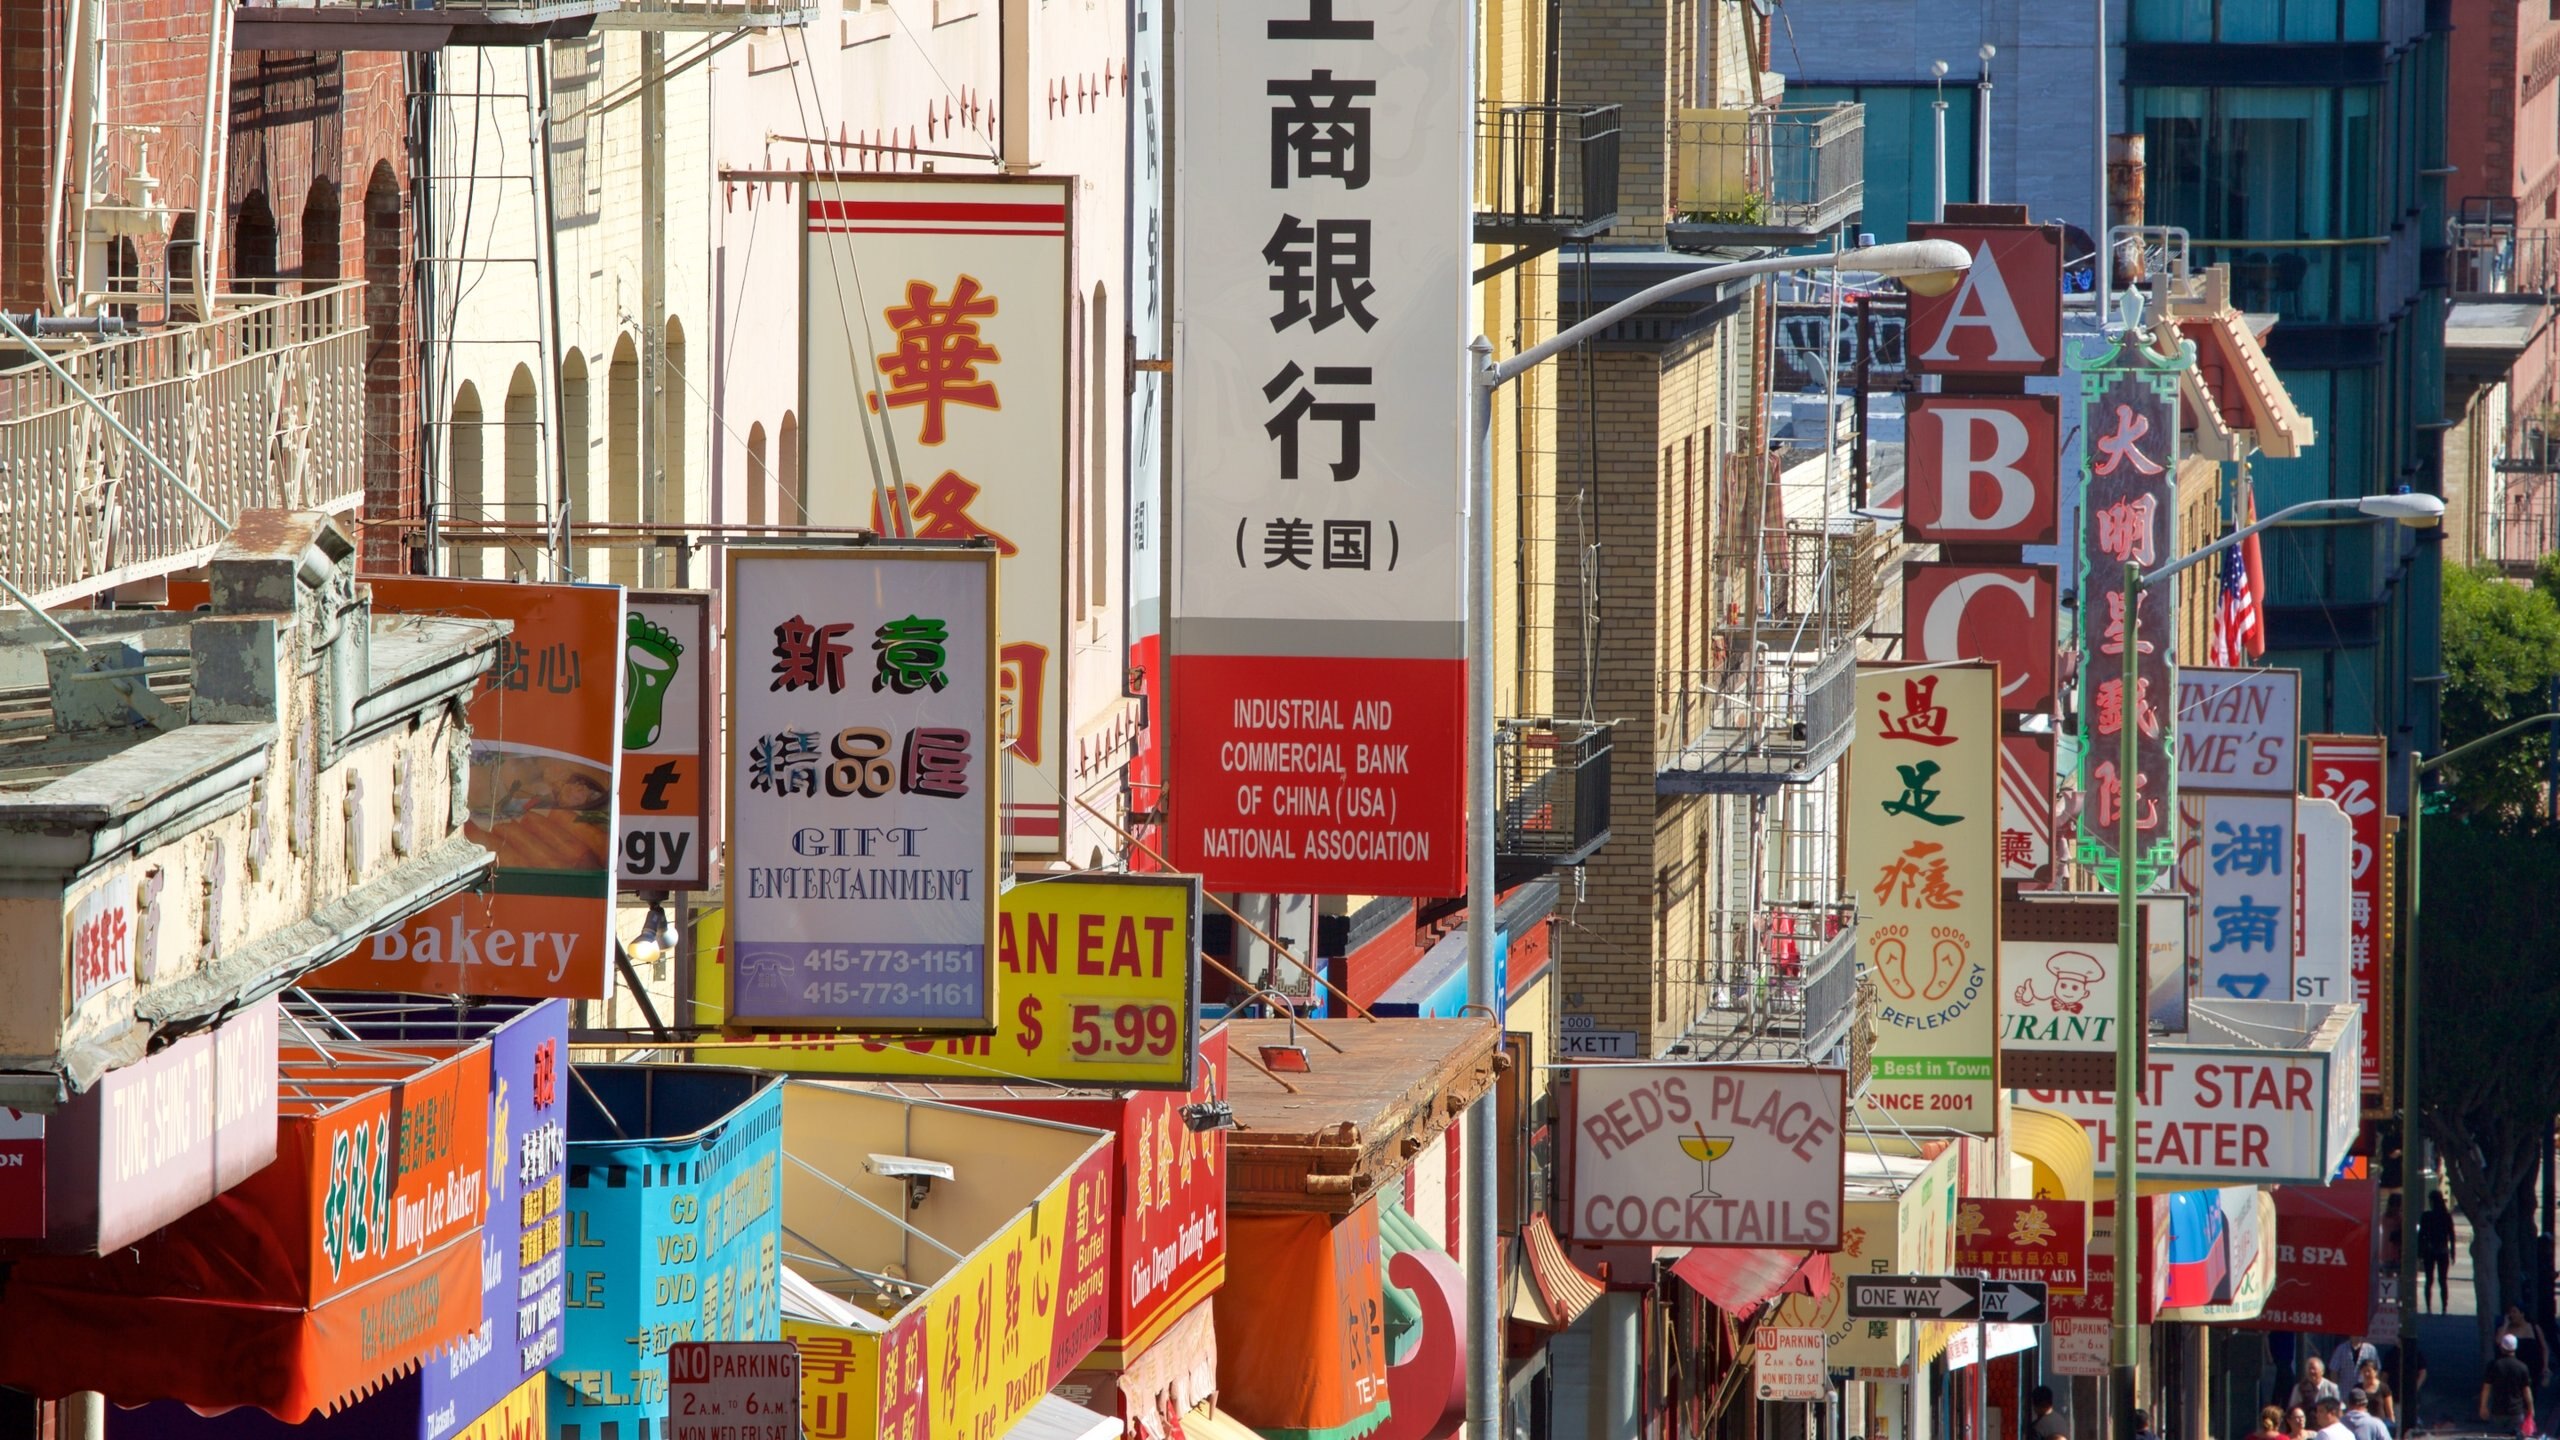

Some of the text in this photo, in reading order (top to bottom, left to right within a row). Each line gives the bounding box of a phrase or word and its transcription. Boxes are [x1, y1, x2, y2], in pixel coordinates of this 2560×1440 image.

[1235, 516, 1400, 572] (美国)
[770, 614, 949, 694] 新意
[1234, 699, 1392, 730] INDUSTRIAL AND
[749, 726, 973, 799] 精品屋
[1221, 741, 1409, 774] COMMERCIAL BANK
[1238, 785, 1262, 815] OF
[1273, 786, 1330, 816] CHINA
[620, 829, 691, 875] gy
[792, 827, 928, 858] GIFT
[1204, 828, 1429, 861] NATIONAL ASSOCIATION
[748, 867, 973, 902] ENTERTAINMENT
[372, 915, 580, 982] Bakery
[804, 949, 973, 973] 415-773-1151
[1078, 914, 1174, 978] EAT
[804, 982, 973, 1006] 415-773-1161
[1882, 963, 1986, 1030] REFLEXOLOGY
[2296, 977, 2330, 997] ST
[1017, 993, 1043, 1057] $
[1072, 1003, 1177, 1057] 5.99
[1884, 1061, 1922, 1075] Best
[1927, 1061, 1942, 1075] in
[1947, 1061, 1991, 1076] Town
[1867, 1094, 1973, 1110] SINCE 2001
[2193, 1064, 2314, 1112] STAR
[1582, 1075, 1834, 1164] RED'S PLACE
[396, 1195, 425, 1255] Wong
[426, 1183, 444, 1236] Lee
[446, 1164, 481, 1227] Bakery
[671, 1195, 698, 1223] CD
[1076, 1169, 1107, 1243] 點心
[1585, 1195, 1830, 1243] COCKTAILS
[657, 1234, 697, 1264] VCD
[1077, 1227, 1105, 1273] Buffet
[1131, 1205, 1218, 1309] China Dragon Trading Inc.
[2302, 1247, 2347, 1266] SPA
[656, 1273, 696, 1306] DVD
[1067, 1266, 1104, 1317] Catering
[2051, 1269, 2076, 1282] ARTS
[2087, 1269, 2142, 1284] Exche
[1861, 1288, 1940, 1306] ONE WAY
[1757, 1330, 1820, 1349] NO PARKING
[2054, 1319, 2107, 1335] NO PARKING
[674, 1347, 791, 1379] NO PARKING
[1764, 1353, 1772, 1366] 2
[1795, 1354, 1803, 1367] 6
[1004, 1355, 1047, 1422] Pastry
[1762, 1373, 1819, 1385] MON WED FRI SAT
[683, 1392, 696, 1415] 2
[700, 1402, 724, 1415] A.M.
[746, 1392, 758, 1415] 6
[763, 1401, 787, 1415] A.M.
